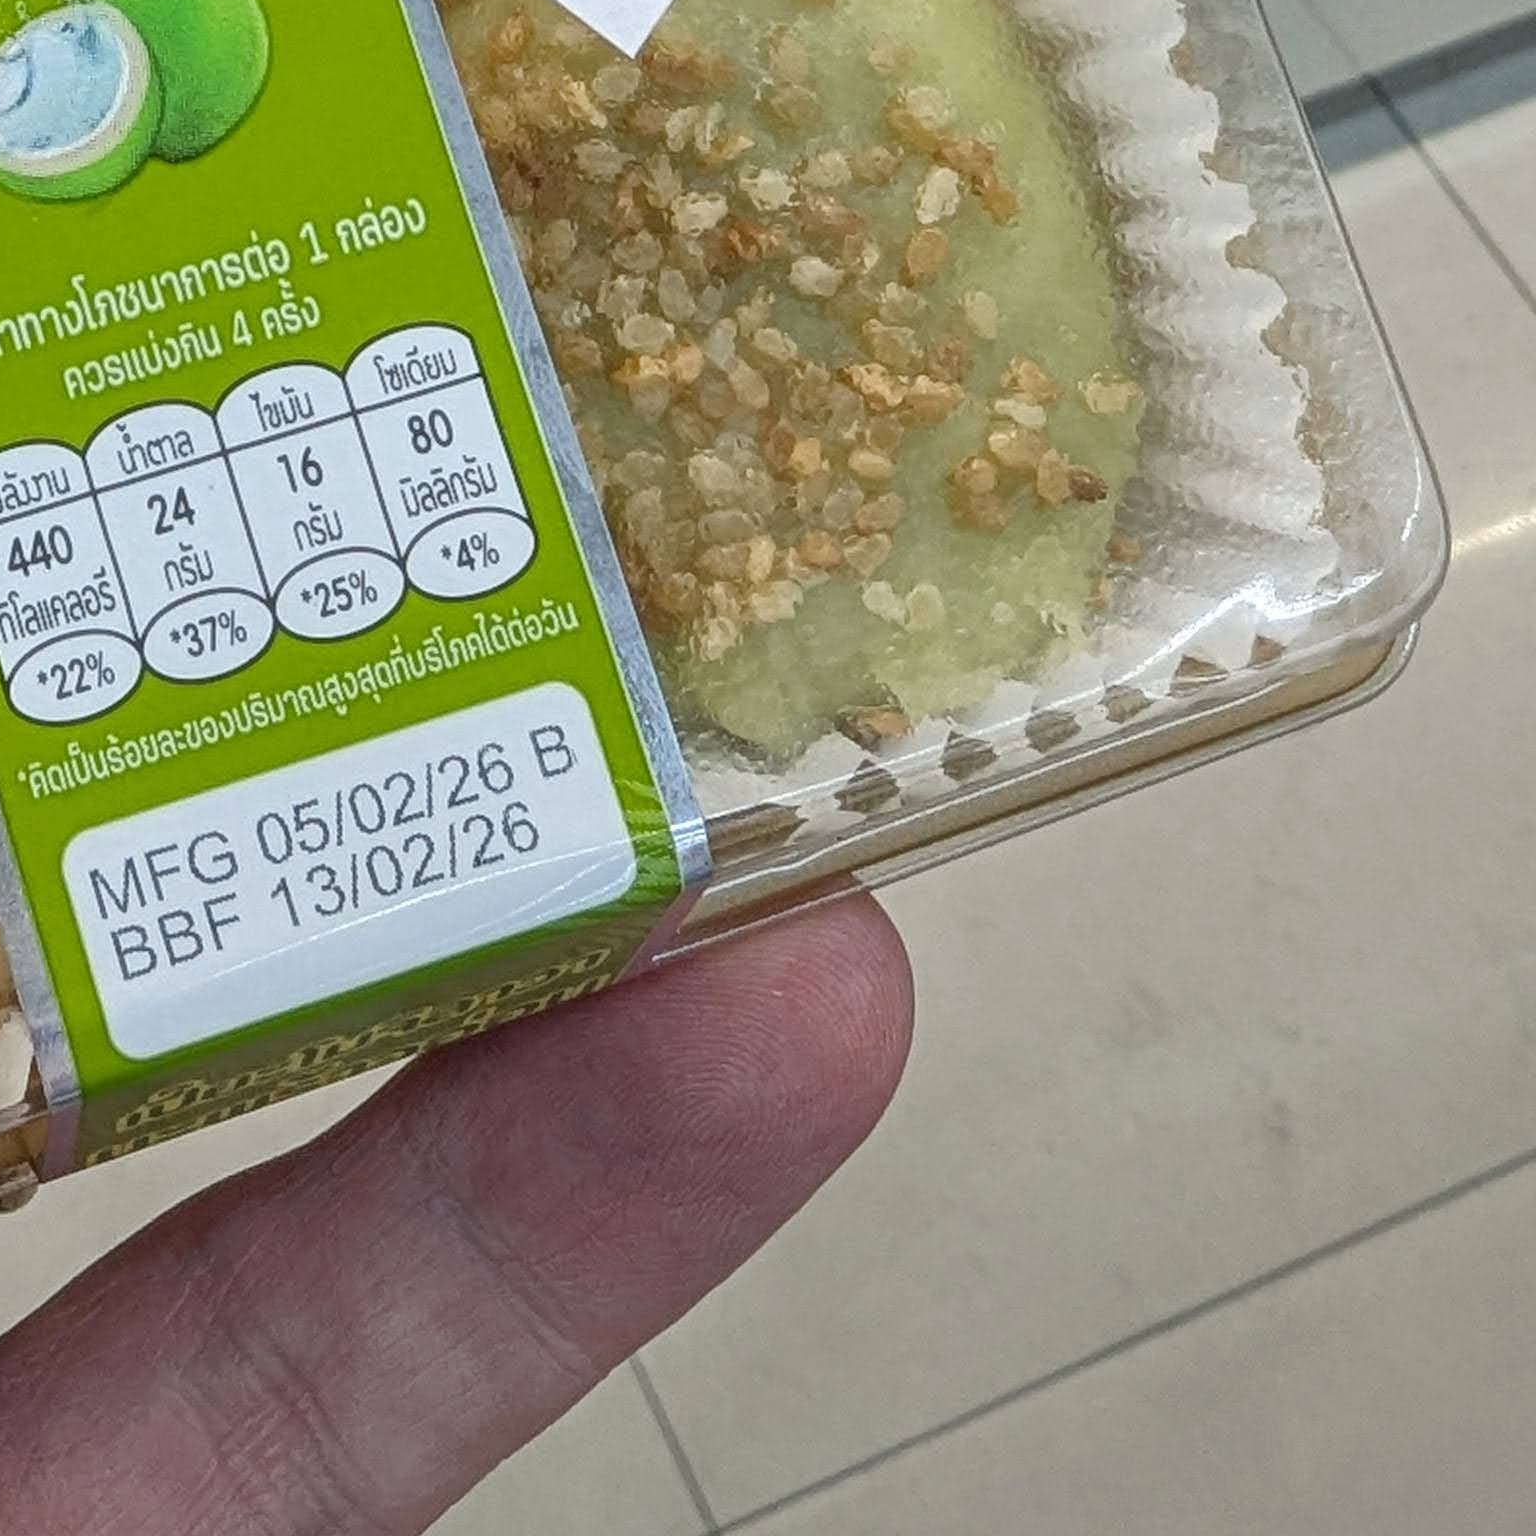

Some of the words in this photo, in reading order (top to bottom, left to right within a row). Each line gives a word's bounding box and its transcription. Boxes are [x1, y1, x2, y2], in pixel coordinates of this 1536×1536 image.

[297, 221, 329, 265] 1
[335, 196, 428, 255] กล่อง
[63, 324, 224, 401] ควรแบ่งกิน
[230, 310, 254, 348] 4
[262, 280, 322, 342] ครั้ง
[373, 347, 459, 396] โซเดียม
[250, 386, 316, 434] ไขมัน
[406, 407, 455, 456] 80
[116, 422, 196, 478] น้ำตาล
[277, 445, 325, 495] 16
[146, 485, 197, 537] 24
[399, 454, 499, 519] มิลลิกรัม
[7, 525, 74, 578] 440
[292, 502, 344, 554] กรัม
[163, 542, 215, 593] กรัม
[89, 830, 240, 920] MFG
[254, 741, 515, 866] 05/02/26
[528, 724, 576, 779] B
[110, 892, 244, 982] BBF
[270, 801, 541, 928] 13/02/26
